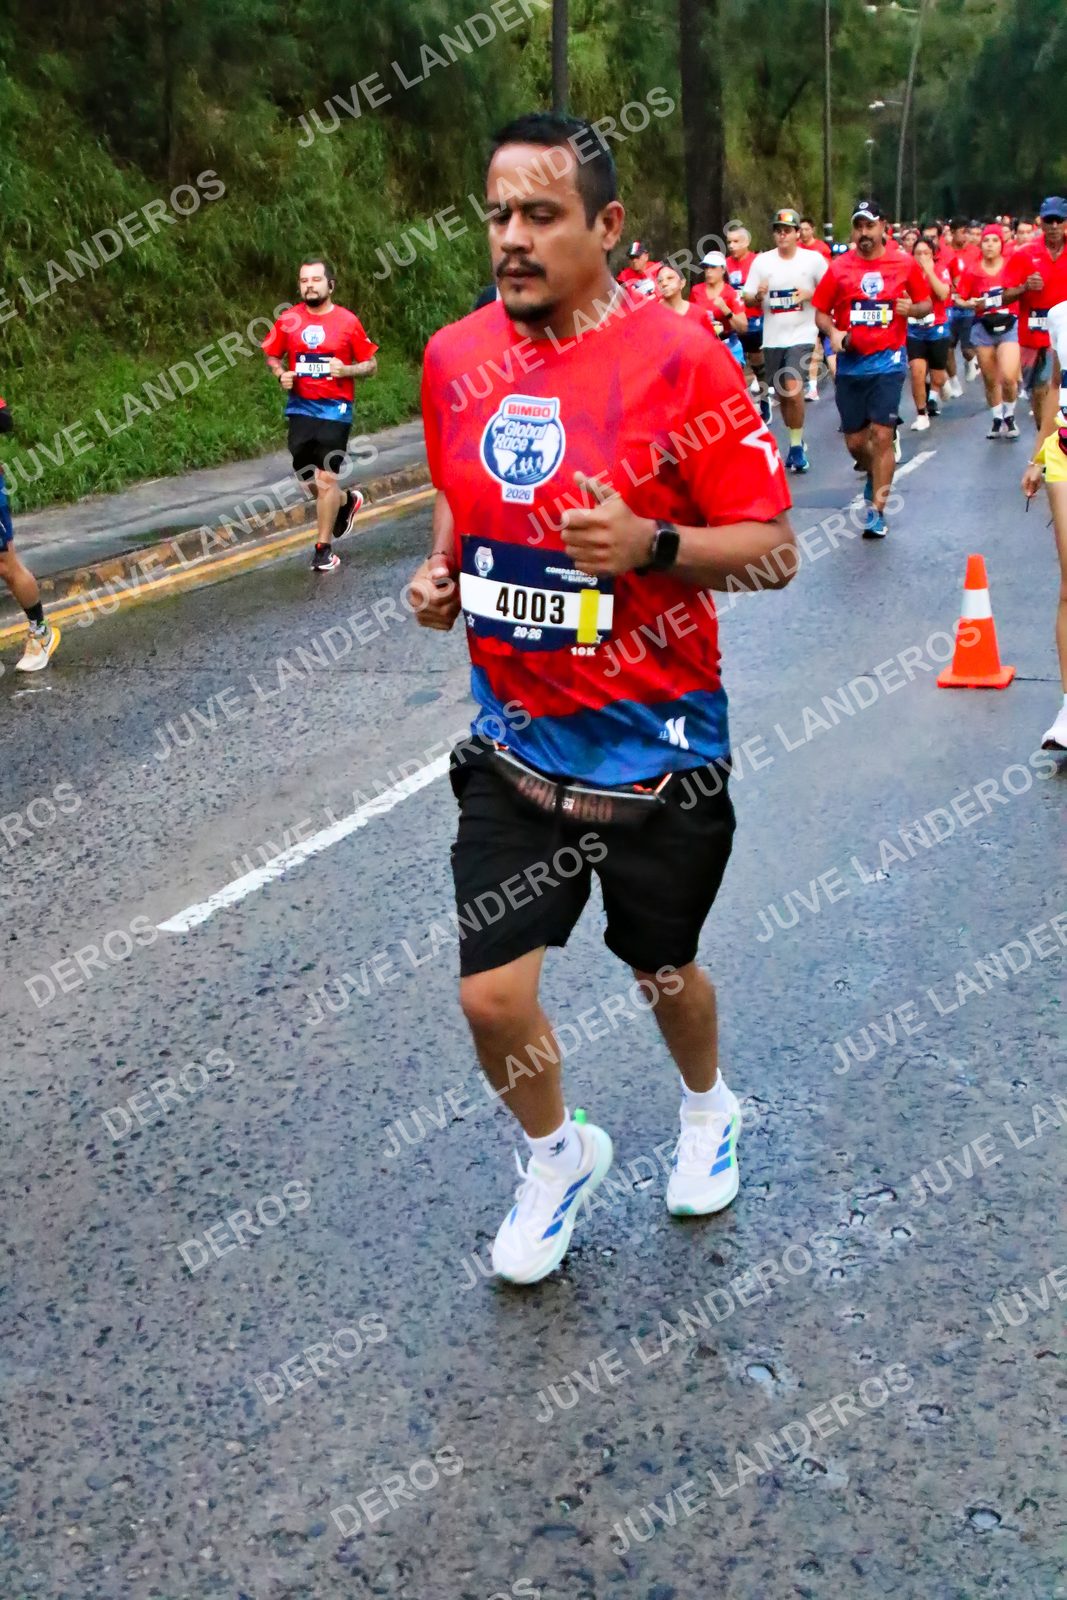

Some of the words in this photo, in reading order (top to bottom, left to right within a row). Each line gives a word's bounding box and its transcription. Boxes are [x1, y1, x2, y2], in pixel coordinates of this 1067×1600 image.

[309, 364, 323, 372] 4751
[508, 404, 551, 418] BIMBO
[504, 421, 547, 440] Global
[494, 433, 529, 452] Race
[506, 487, 531, 500] 2026
[496, 586, 565, 624] 4003
[513, 626, 543, 640] 20-26
[570, 646, 596, 656] 10K
